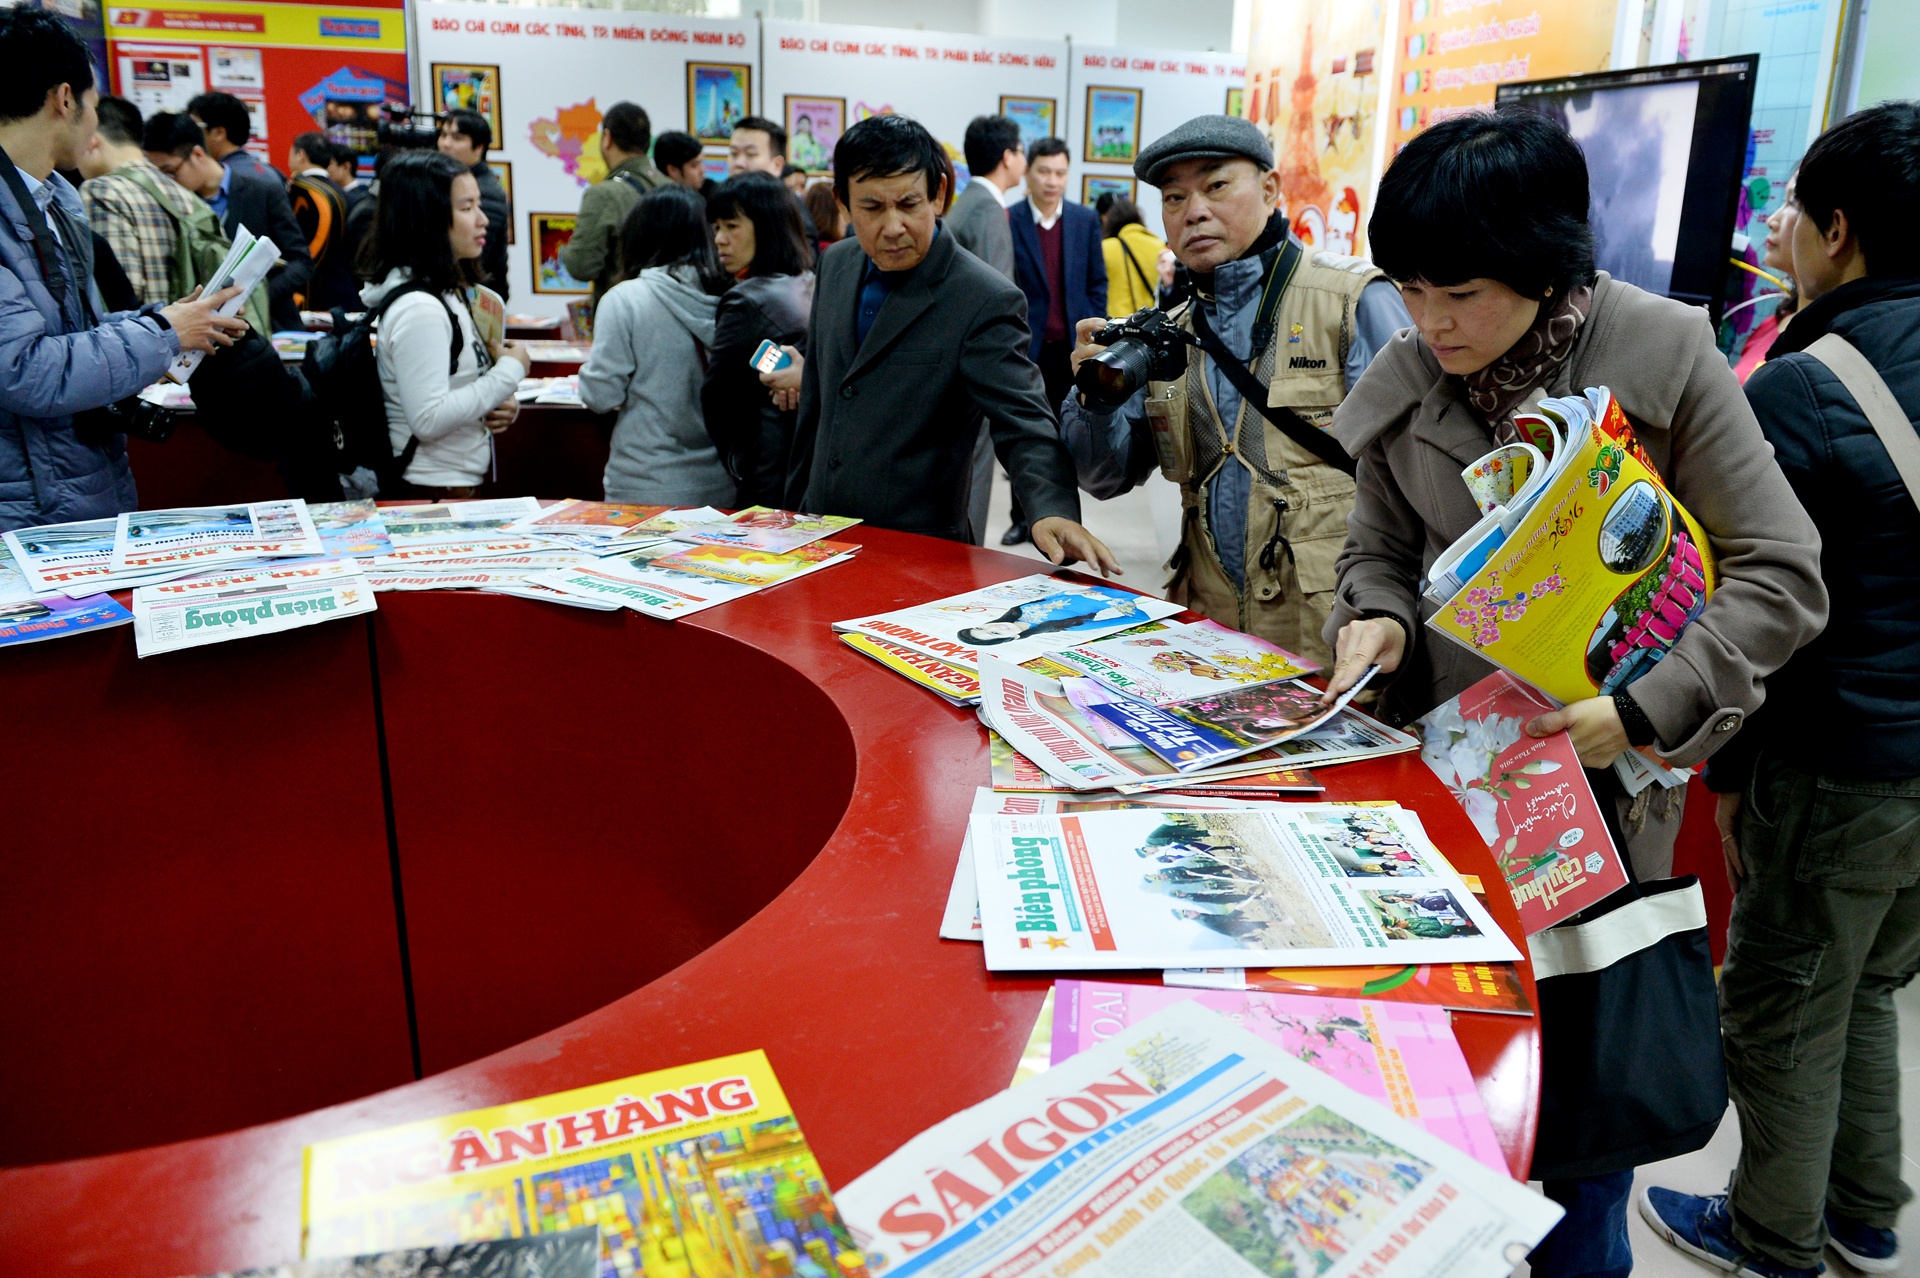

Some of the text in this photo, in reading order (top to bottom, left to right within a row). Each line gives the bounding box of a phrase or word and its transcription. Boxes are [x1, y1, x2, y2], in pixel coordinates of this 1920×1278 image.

[432, 18, 460, 31] BÁO
[465, 19, 485, 33] CHÍ
[491, 21, 520, 36] CỤM
[526, 22, 549, 36] CÁC
[613, 25, 645, 40] MIỀN
[650, 28, 688, 43] ĐÔNG
[693, 31, 723, 44] NAM
[728, 32, 746, 48] BỘ
[780, 36, 805, 50] BÁO
[810, 39, 828, 52] CHÍ
[834, 40, 860, 54] CỤM
[865, 43, 886, 57] CÁC
[1084, 54, 1107, 68] BÁO
[1111, 55, 1127, 69] CHÍ
[1132, 58, 1155, 72] CỤM
[1160, 60, 1179, 73] CÁC
[1123, 326, 1140, 334] Nikon
[1288, 356, 1327, 370] Nikon
[124, 549, 219, 566] ninh
[1508, 536, 1548, 579] Xuân Bính Thân
[157, 576, 258, 593] ninh
[565, 575, 632, 594] phòng
[622, 588, 670, 606] Biên
[185, 595, 337, 630] Biên phòng
[858, 620, 934, 647] THÔNG
[1107, 670, 1135, 687] Môi
[1001, 678, 1033, 713] Nam
[1007, 712, 1051, 729] Việt
[1025, 726, 1068, 742] nói
[1044, 739, 1094, 763] Tiếng
[1540, 793, 1577, 821] Chúc
[1012, 836, 1062, 934] Biên phòng
[1452, 973, 1473, 992] CHÀO
[1474, 966, 1499, 995] ĐẠI HỘI
[334, 1119, 551, 1199] NGÂN
[556, 1077, 758, 1152] HÀNG
